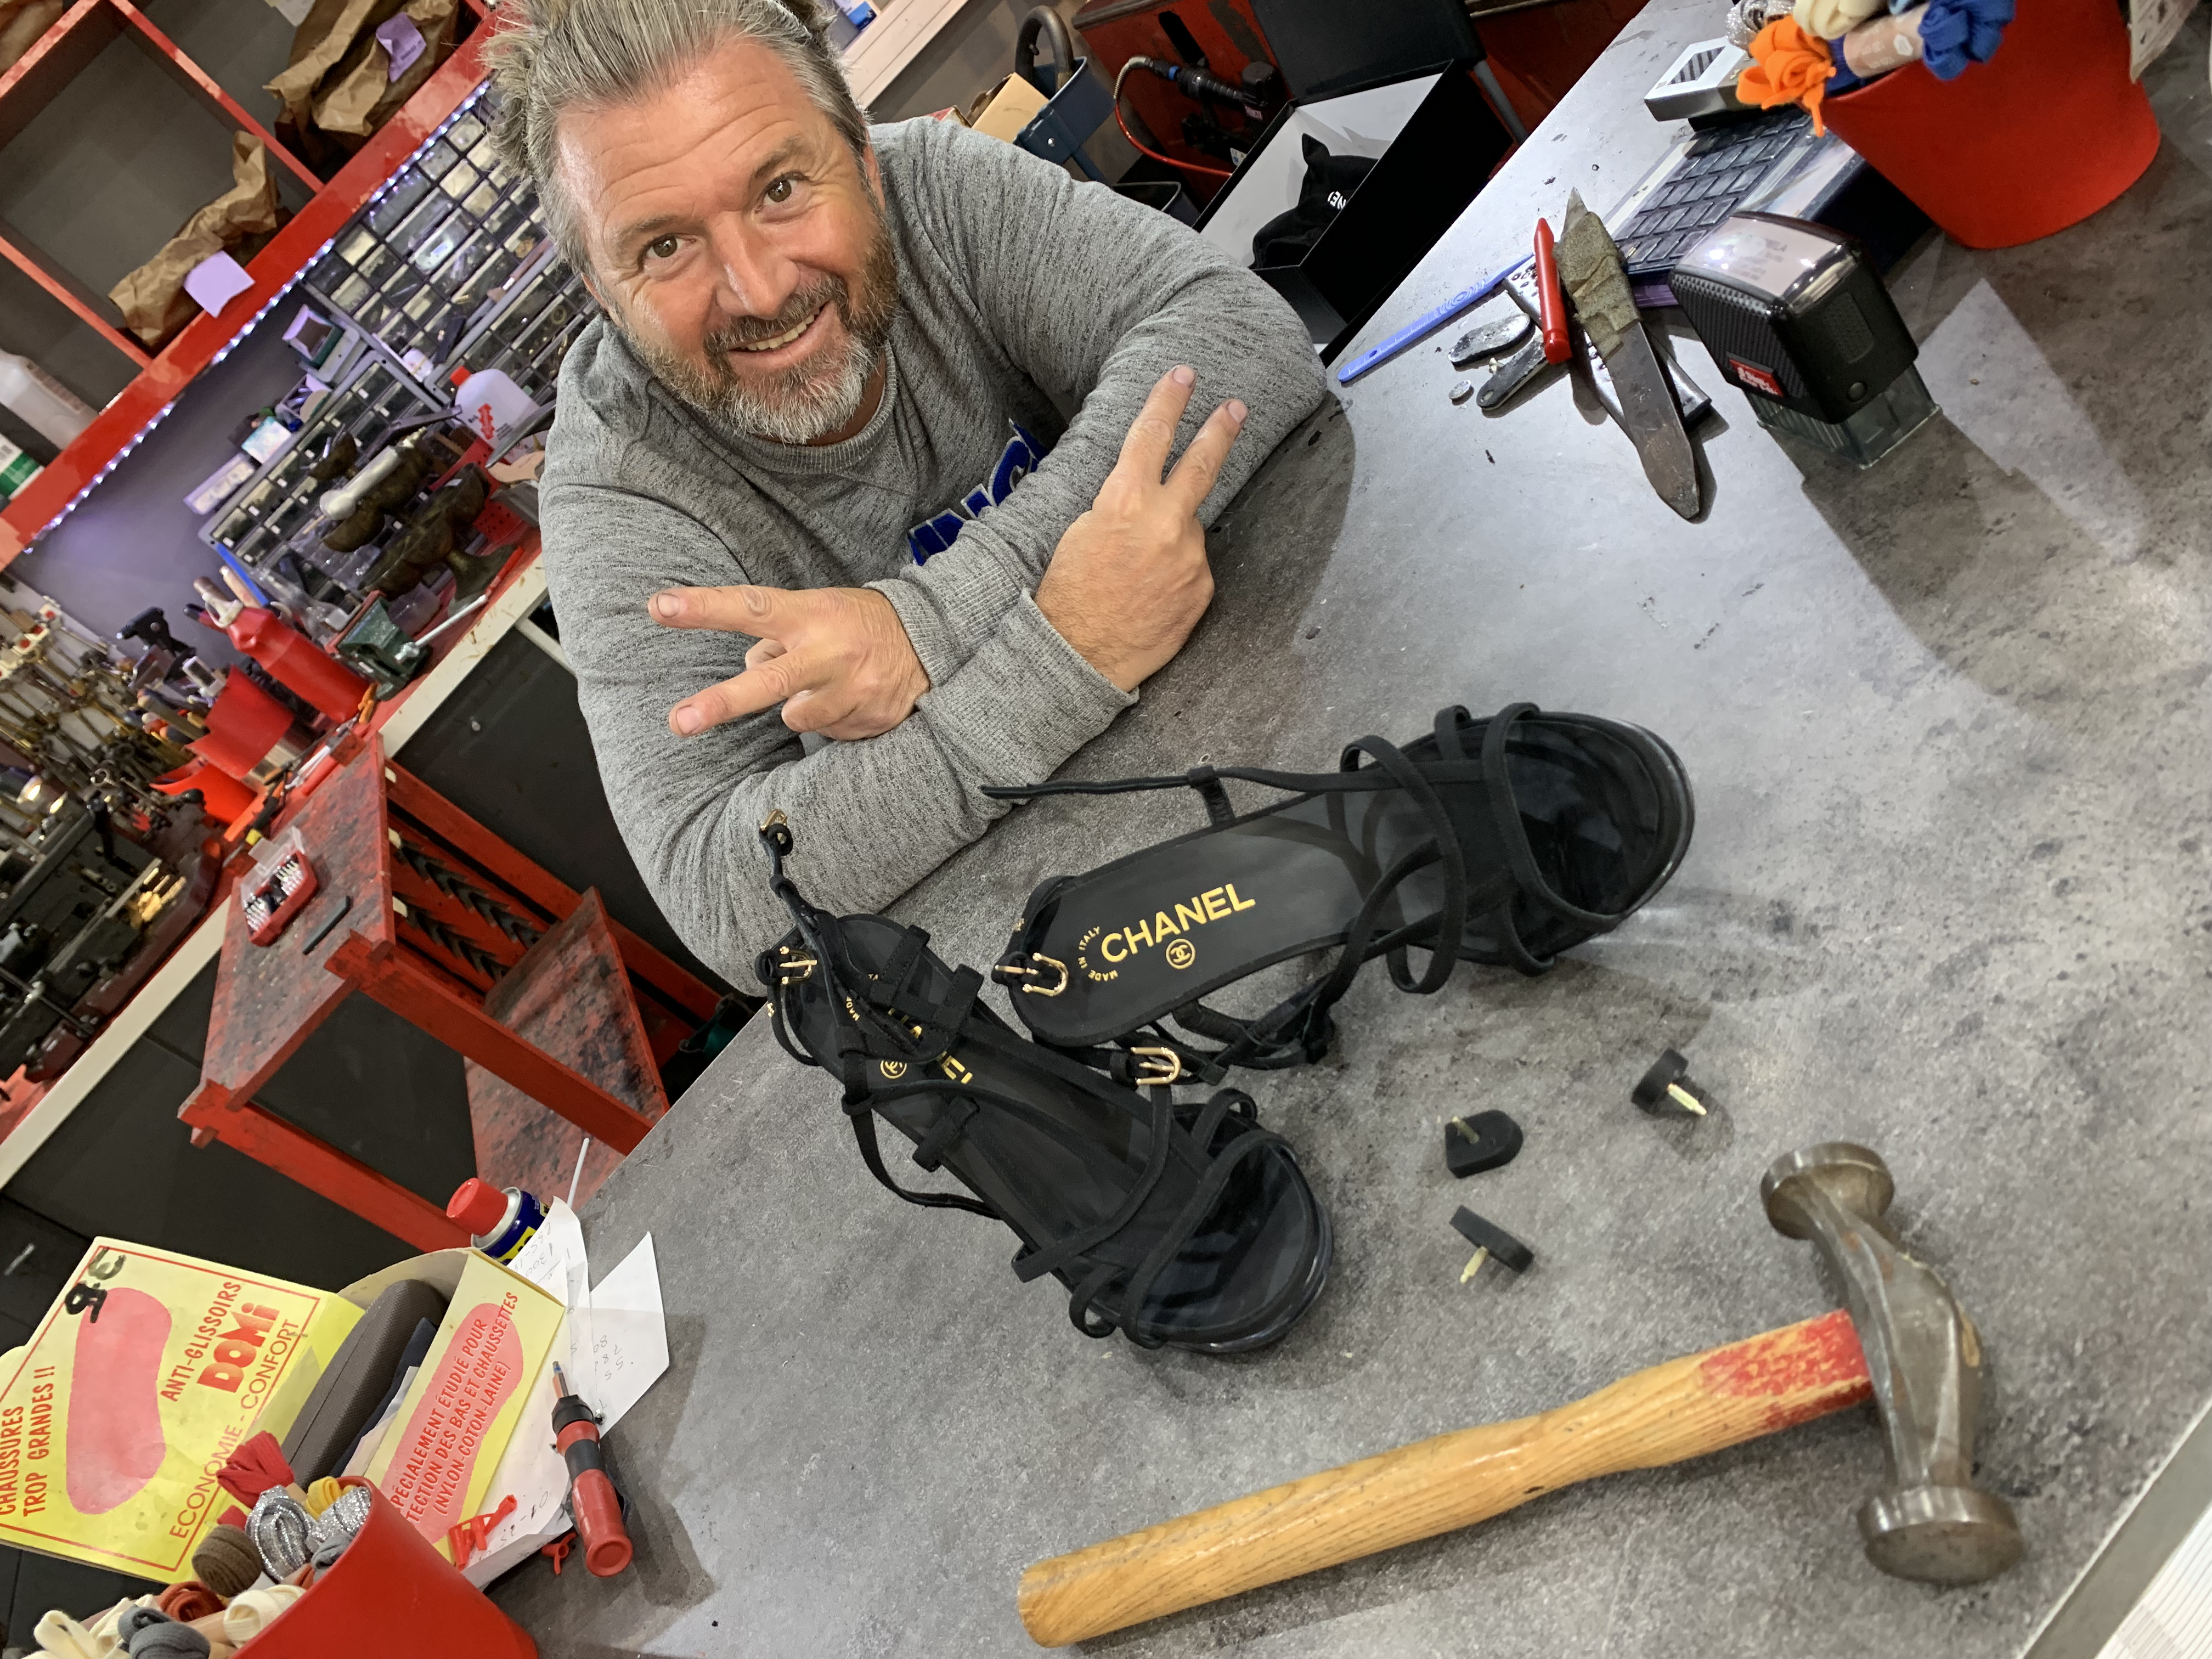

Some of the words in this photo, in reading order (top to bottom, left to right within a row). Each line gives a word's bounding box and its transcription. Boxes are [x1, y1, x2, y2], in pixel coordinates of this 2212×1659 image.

[1078, 926, 1100, 951] ITALY
[1078, 956, 1088, 969] IN
[1101, 883, 1256, 962] CHANEL
[1088, 969, 1119, 981] MADE
[160, 1282, 241, 1401] ANTI-GLISSOIRS
[27, 1384, 53, 1459] GRANDES
[169, 1425, 243, 1538] ECONOMIE
[241, 1319, 299, 1409] CONFORT
[390, 1408, 445, 1506] PÉCIALEMENT
[435, 1356, 469, 1408] ÉTUDIÉ
[462, 1319, 488, 1357] POUR
[406, 1462, 443, 1522] TECTION
[435, 1430, 456, 1459] DES
[449, 1400, 471, 1429] BAS
[464, 1378, 480, 1398] ET
[473, 1291, 518, 1379] CHAUSSETTES
[433, 1361, 511, 1515] (NYLON-COTON-LAINE)
[0, 1406, 24, 1515] CHAUSSURES
[23, 1472, 47, 1516] TROP
